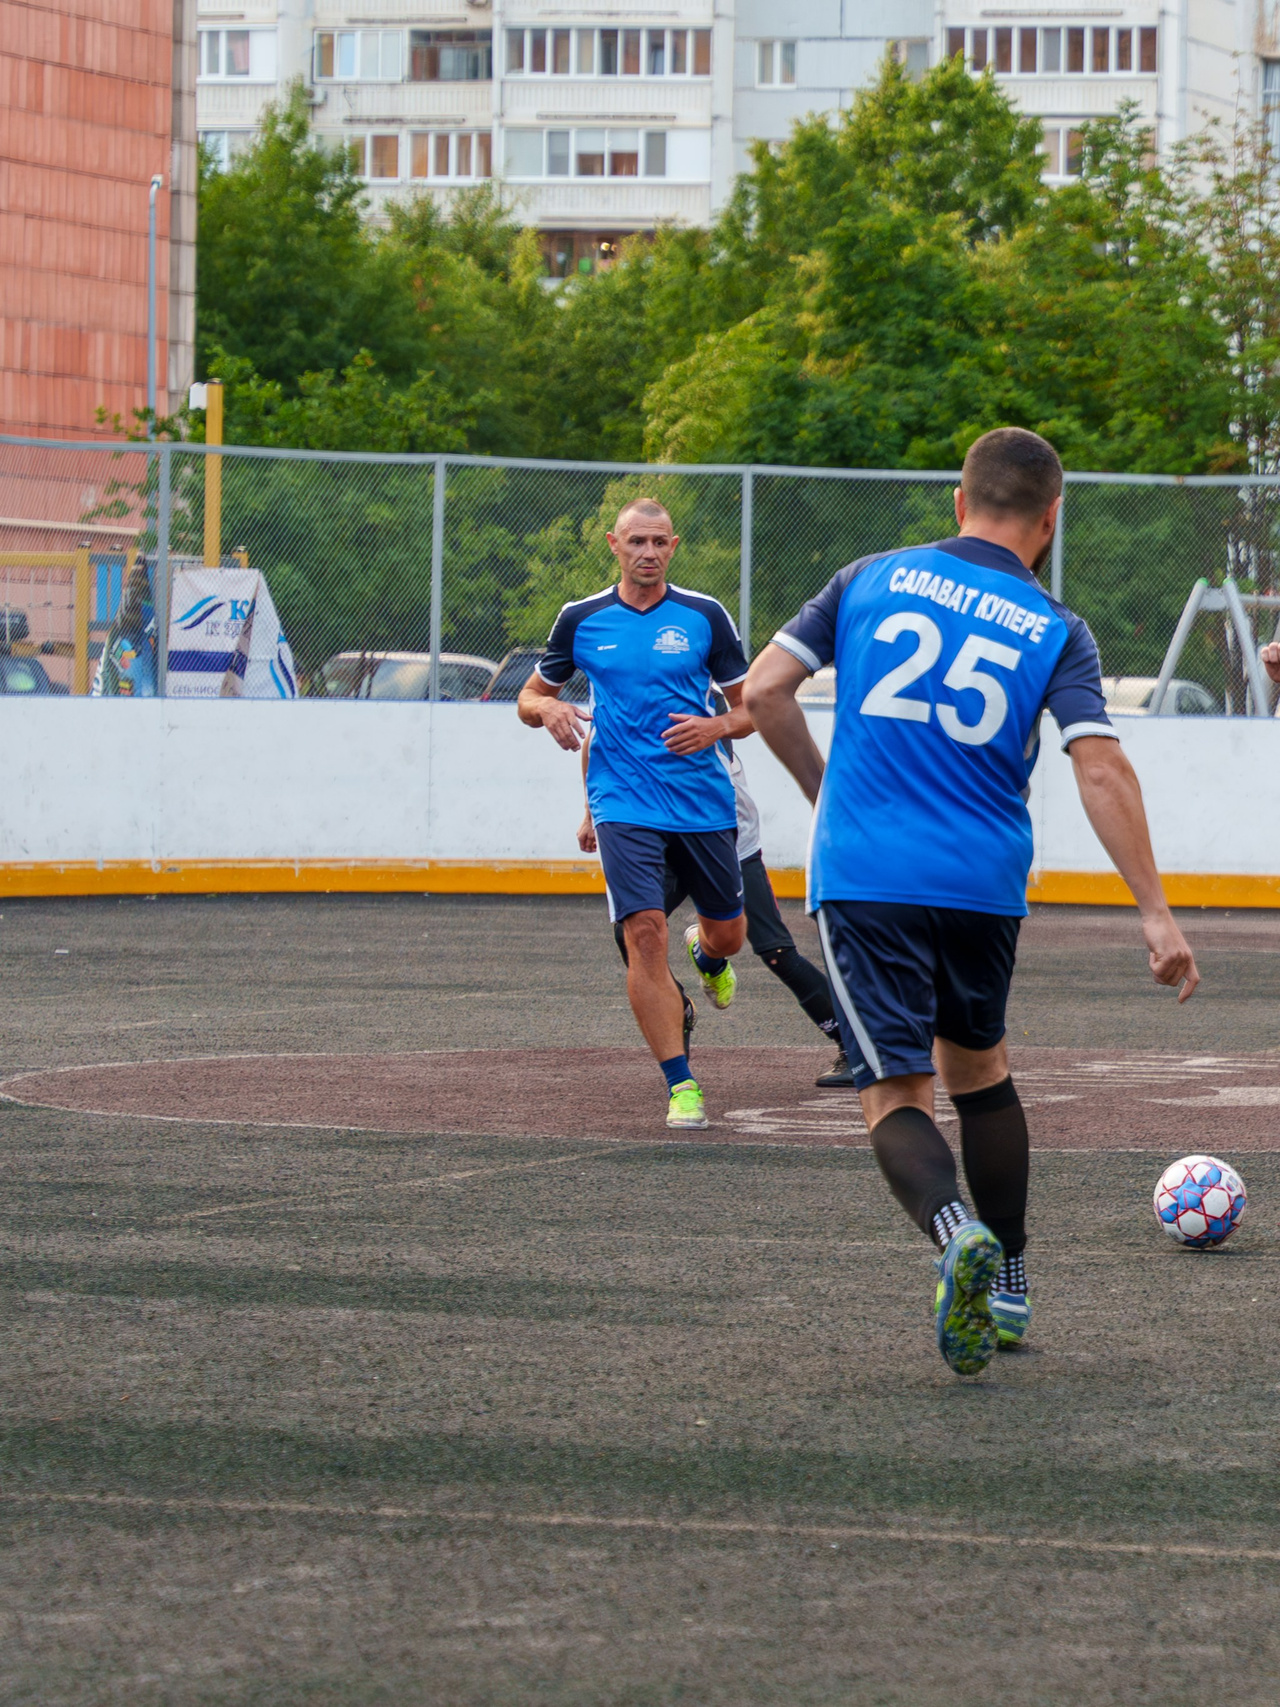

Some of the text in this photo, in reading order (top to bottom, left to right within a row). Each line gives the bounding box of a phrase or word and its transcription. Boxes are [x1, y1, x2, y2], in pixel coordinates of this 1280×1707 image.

[889, 567, 1050, 644] САЛАВАТ КУПЕРЕ
[859, 611, 1022, 746] 25
